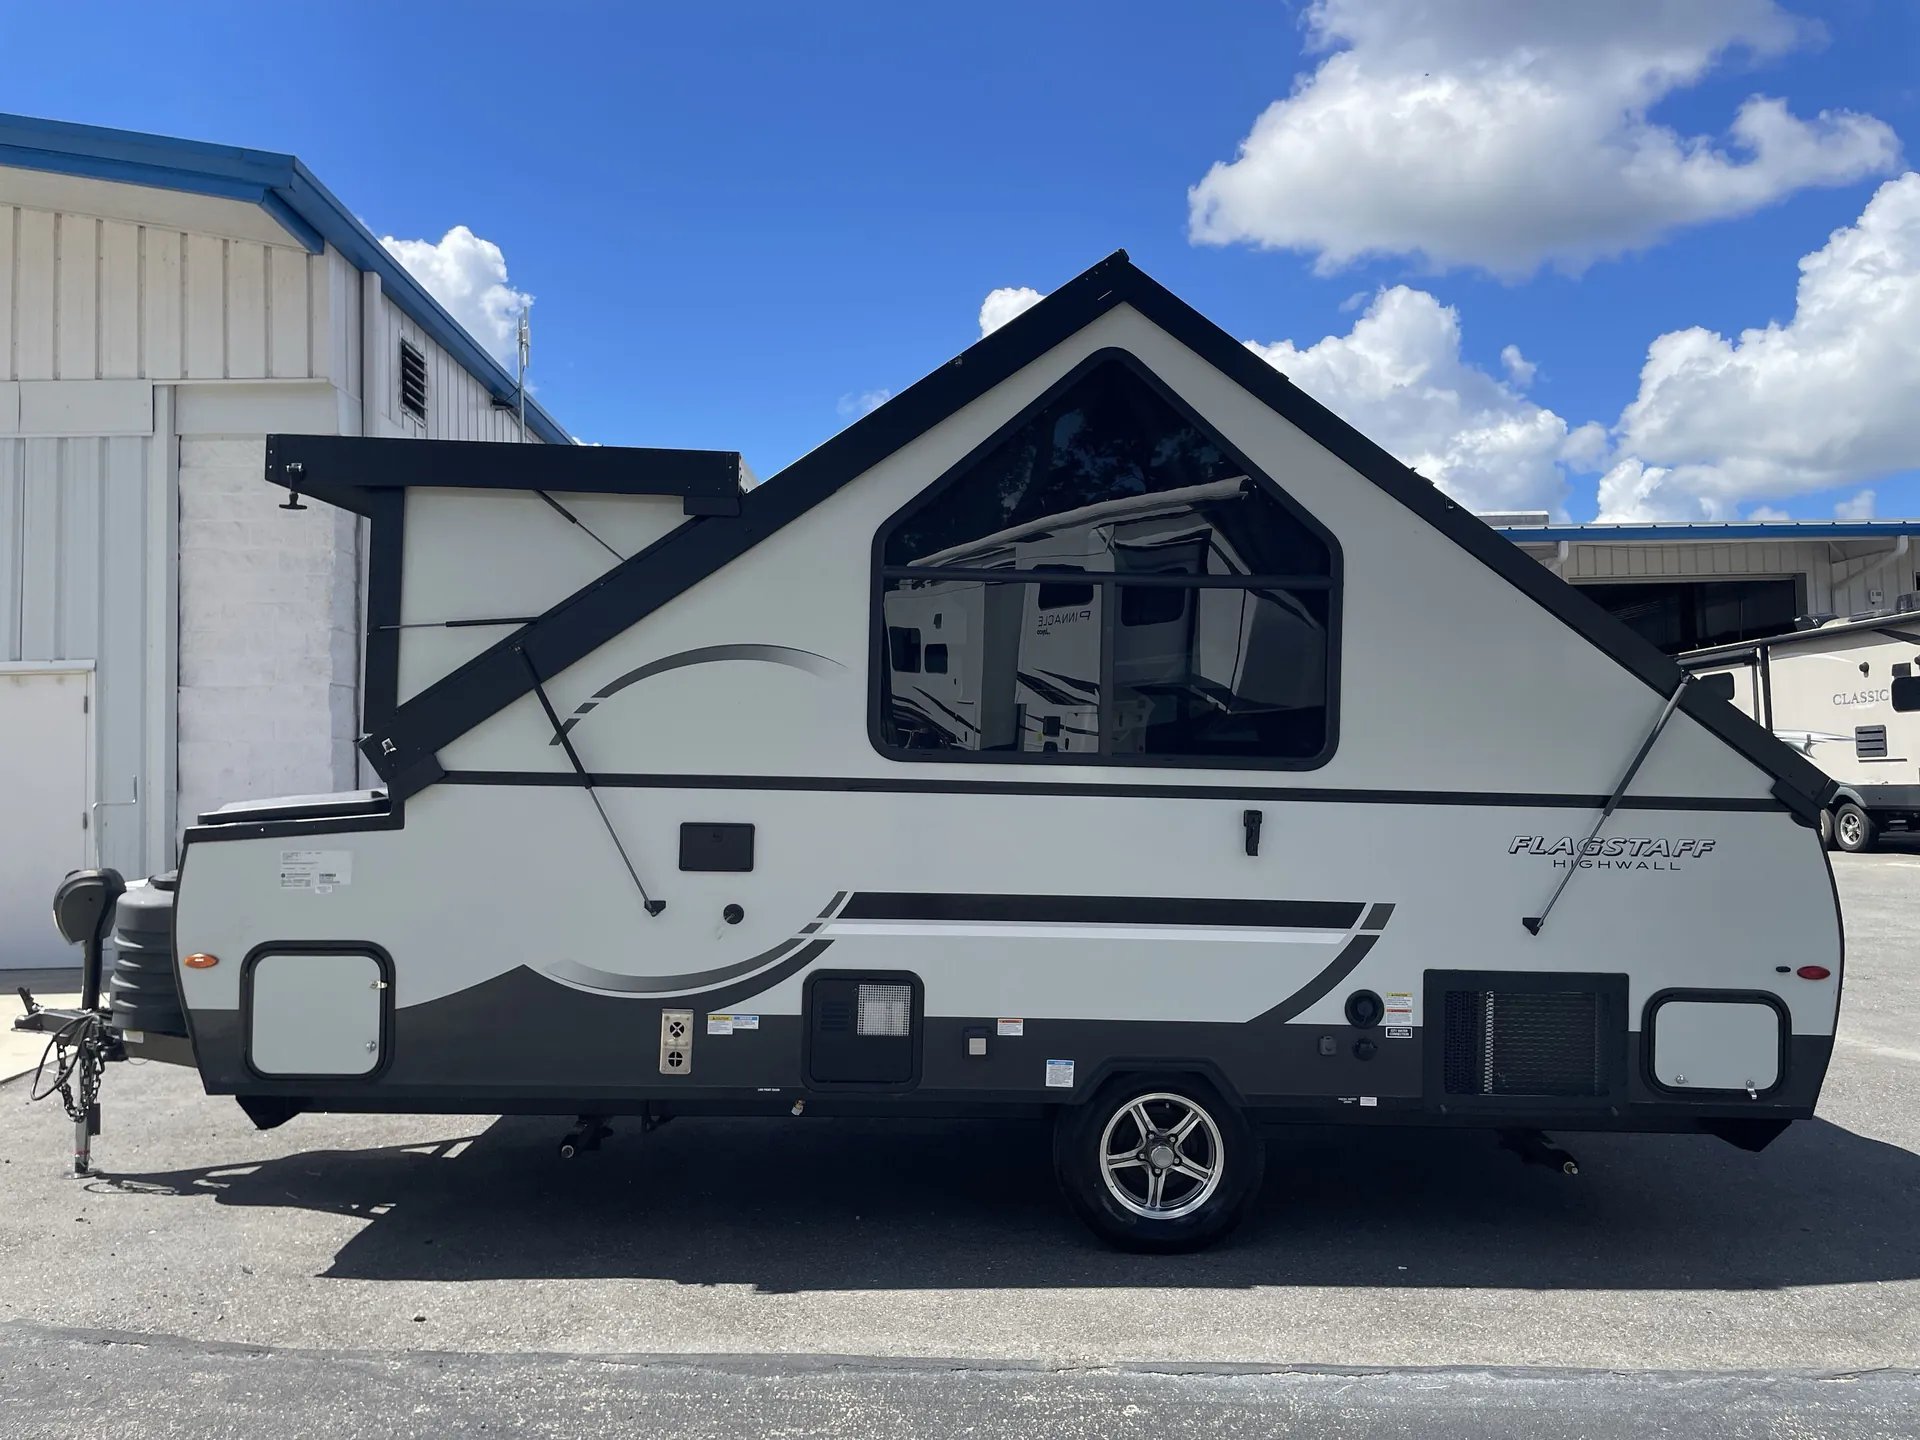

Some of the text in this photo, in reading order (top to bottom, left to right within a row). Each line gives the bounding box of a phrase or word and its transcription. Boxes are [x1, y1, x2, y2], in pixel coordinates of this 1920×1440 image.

[1832, 689, 1889, 705] CLASSIC
[1507, 836, 1716, 858] FLAGSTAFF
[1553, 859, 1681, 870] HIGHWALL
